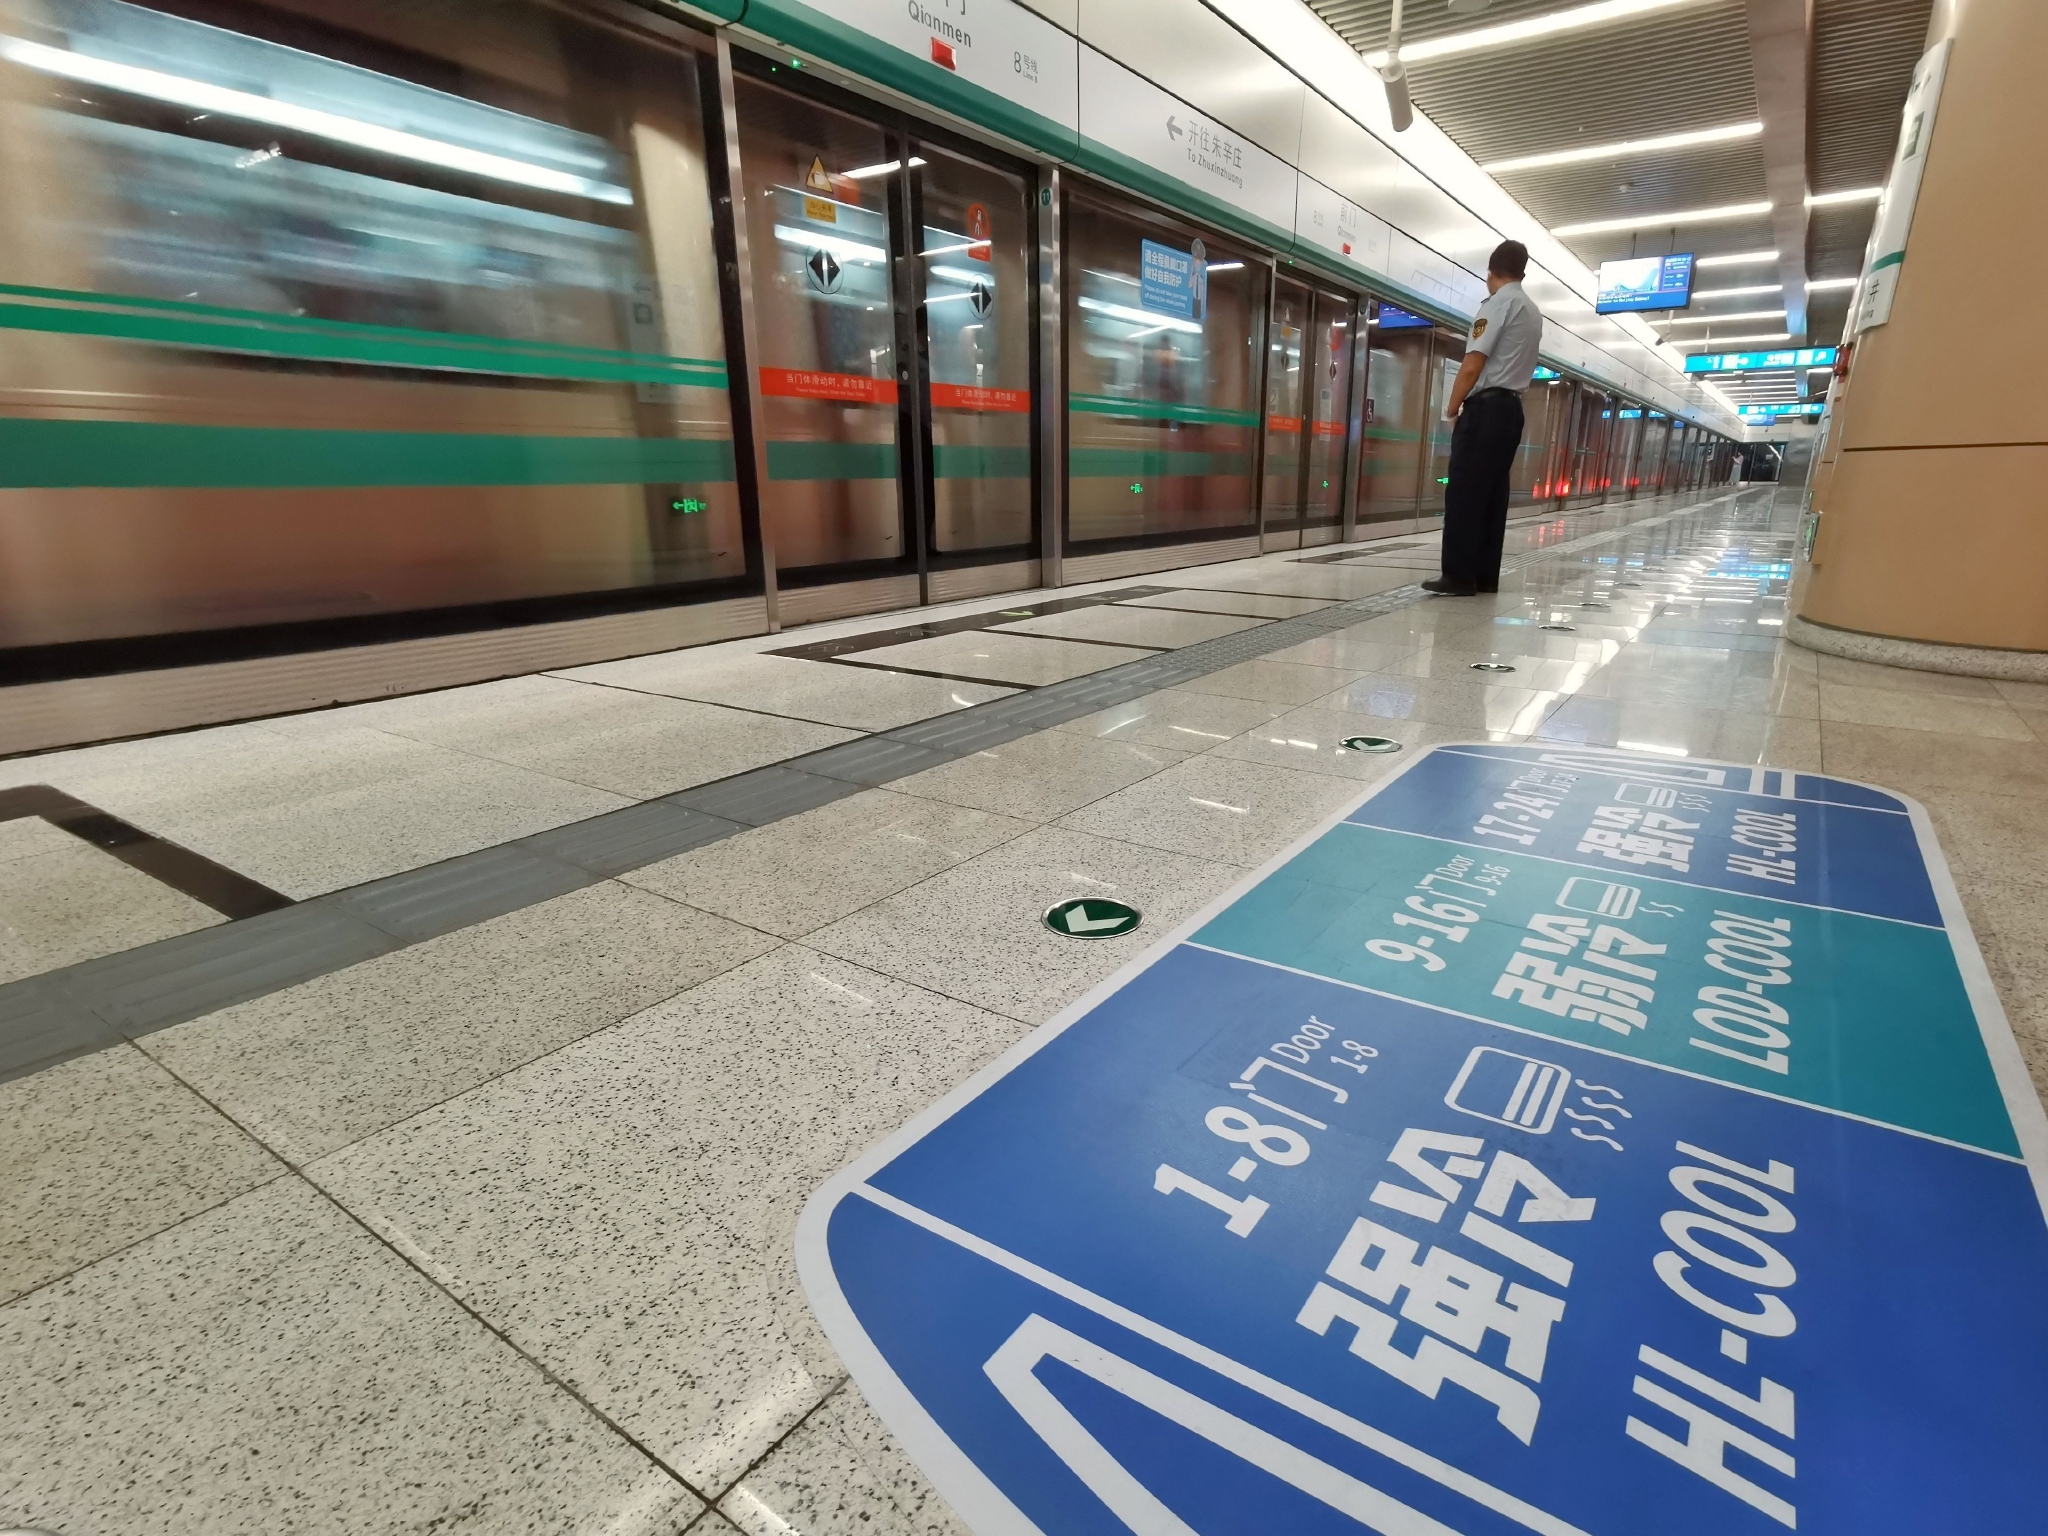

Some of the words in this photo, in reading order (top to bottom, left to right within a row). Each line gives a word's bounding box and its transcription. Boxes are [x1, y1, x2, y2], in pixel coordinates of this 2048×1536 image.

[908, 0, 972, 48] Qianmen
[1187, 147, 1196, 163] To
[1198, 154, 1243, 189] Zhuxinzhuang
[1188, 120, 1242, 169] 开往朱辛庄
[1434, 854, 1475, 878] Door
[1576, 805, 1700, 873] 强冷
[1725, 808, 1796, 885] HL-COOL
[1479, 863, 1512, 886] 9-16
[1365, 873, 1496, 972] 9-16门
[1491, 912, 1668, 1036] 弱冷
[1688, 909, 1793, 1075] LOD-COOL
[1269, 1014, 1336, 1065] Door
[1331, 1039, 1379, 1074] 1-8
[1153, 1056, 1349, 1238] 1-8门
[1295, 1127, 1597, 1446] 强冷
[1625, 1140, 1797, 1530] HL-COOL
